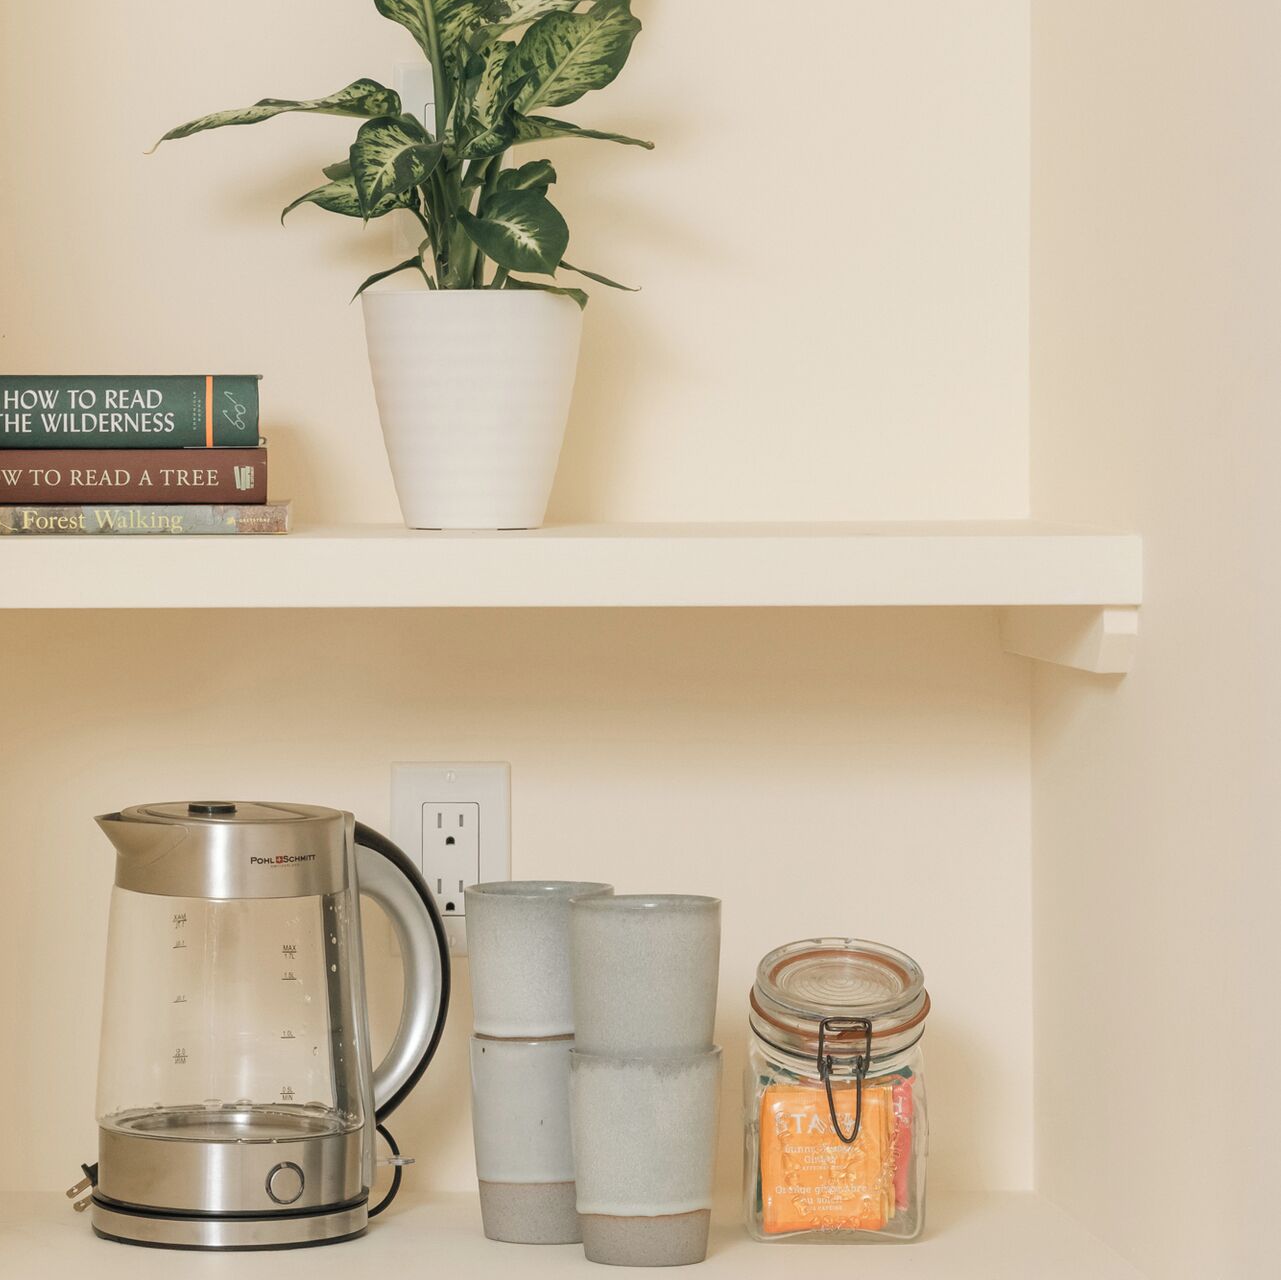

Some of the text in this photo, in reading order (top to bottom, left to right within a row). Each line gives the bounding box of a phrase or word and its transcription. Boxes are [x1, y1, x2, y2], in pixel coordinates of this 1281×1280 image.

[4, 389, 163, 410] HOW TO READ
[40, 412, 175, 433] WILDERNESS
[29, 469, 61, 486] TO
[70, 469, 131, 486] READ
[138, 470, 154, 486] A
[160, 469, 220, 486] TREE
[22, 509, 184, 533] Forest Walking
[250, 856, 275, 865] POHL
